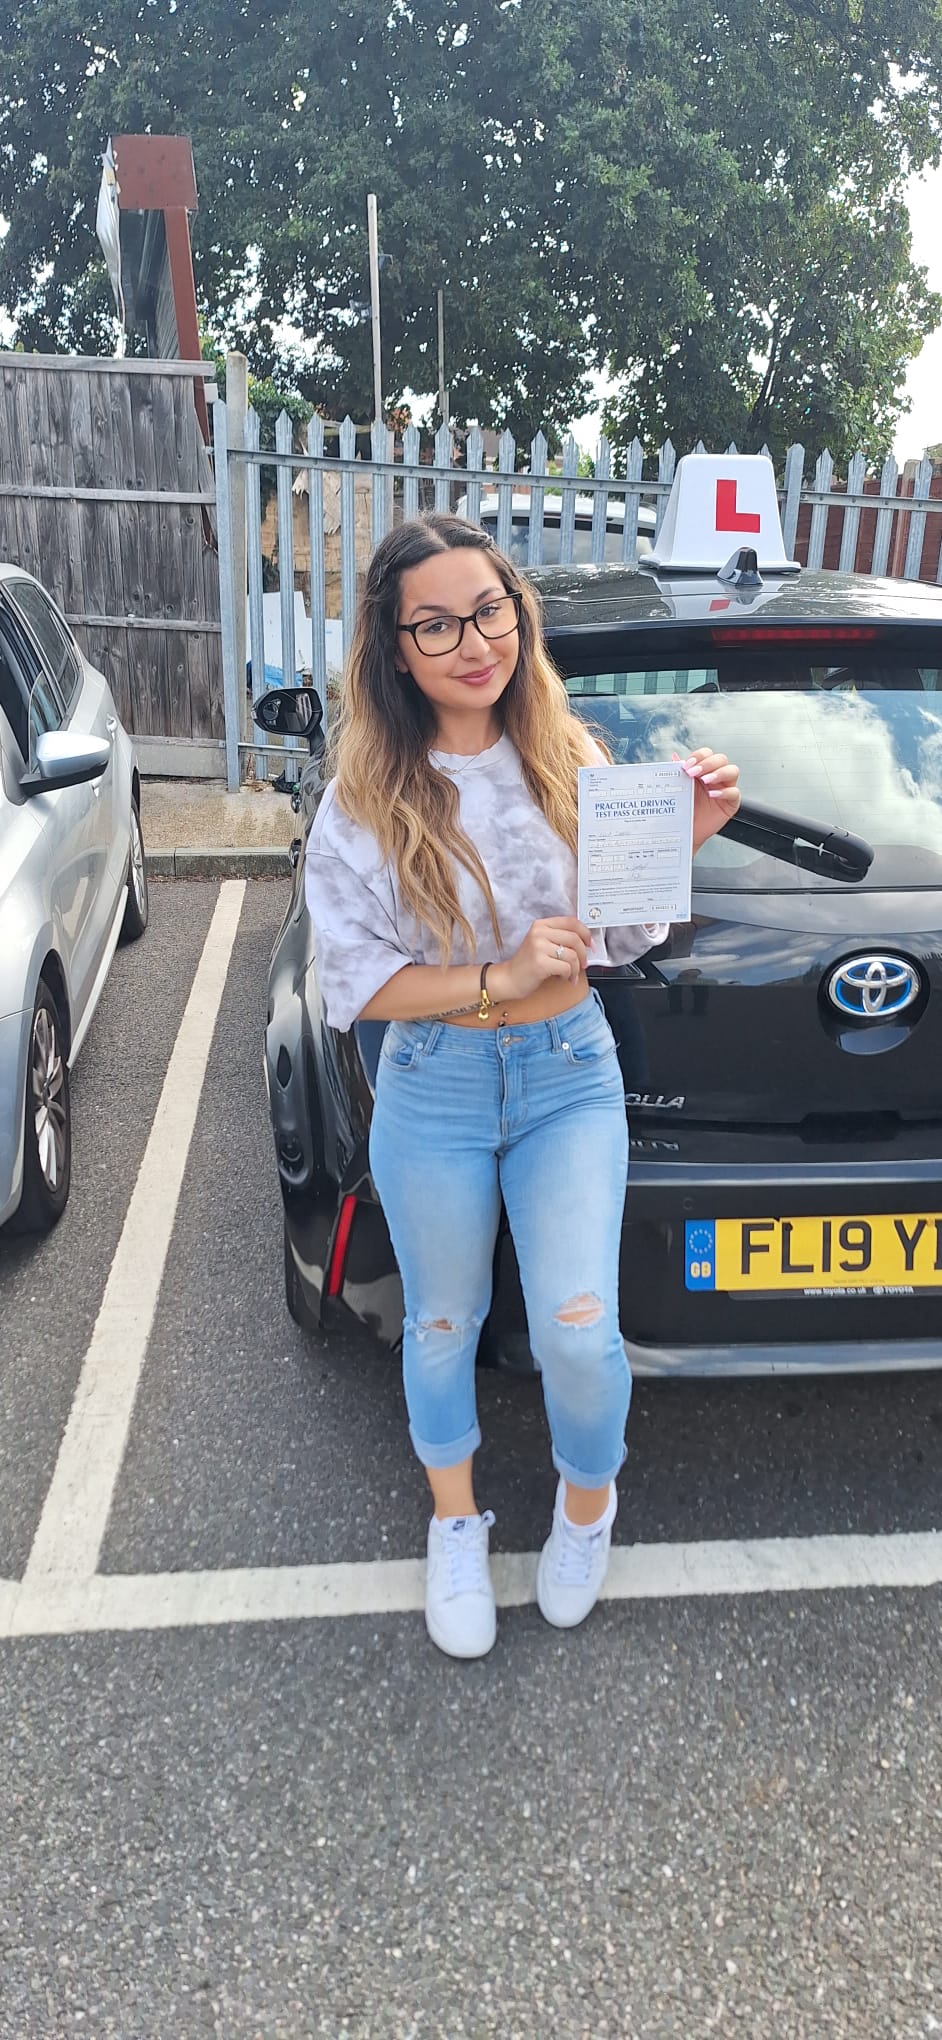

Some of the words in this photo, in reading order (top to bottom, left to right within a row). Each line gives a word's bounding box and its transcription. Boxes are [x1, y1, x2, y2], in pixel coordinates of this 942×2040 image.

[715, 479, 761, 533] L
[595, 801, 638, 811] PRACTICAL
[640, 798, 676, 808] DRIVING
[613, 809, 630, 817] PASS
[631, 807, 675, 817] CERTIFICATE
[741, 1220, 872, 1275] FL19
[690, 1261, 711, 1279] GB
[884, 1285, 914, 1295] TOYOTA
